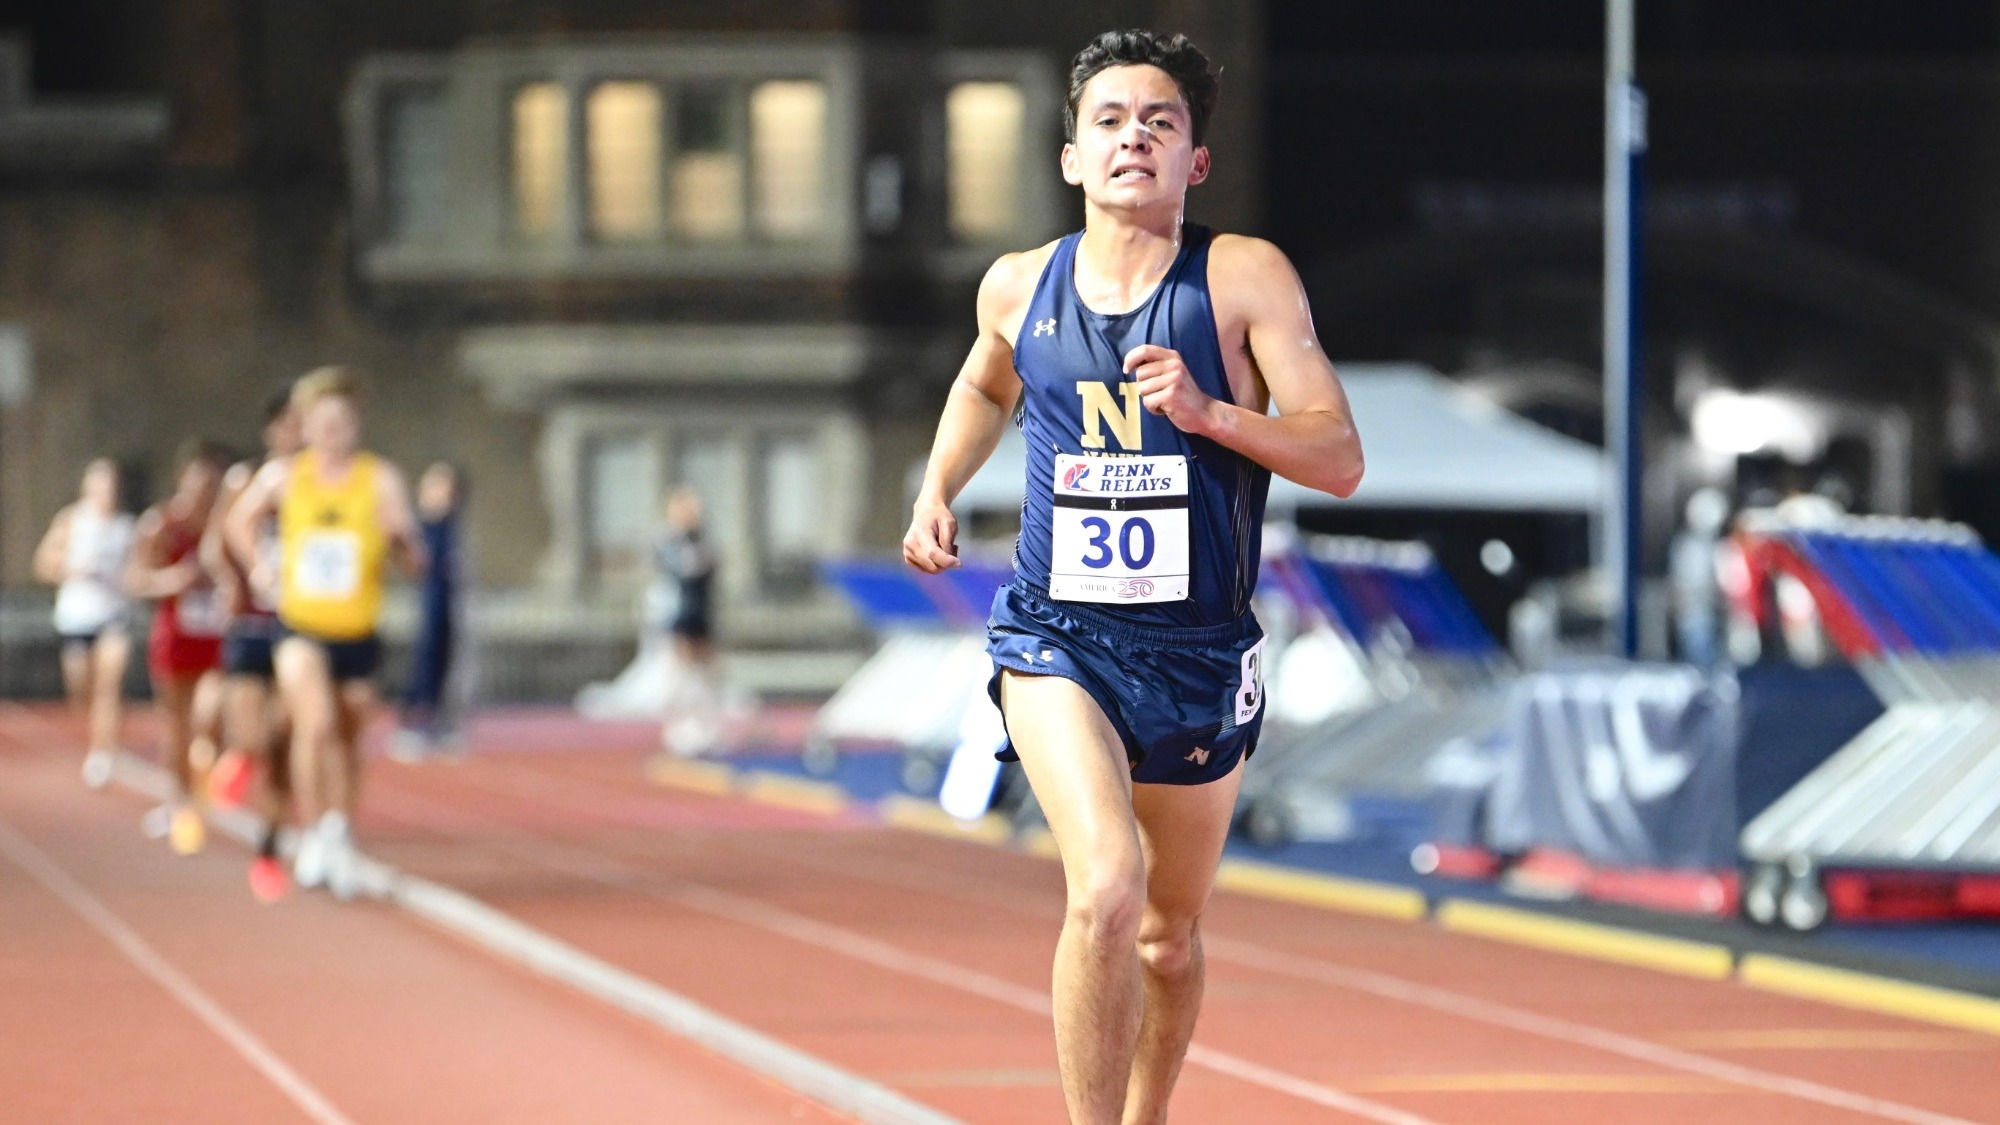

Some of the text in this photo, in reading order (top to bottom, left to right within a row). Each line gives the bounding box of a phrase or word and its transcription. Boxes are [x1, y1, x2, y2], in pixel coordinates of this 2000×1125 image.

[1076, 381, 1142, 450] N
[1102, 464, 1155, 477] PENN
[1100, 477, 1171, 492] RELAYS
[1081, 516, 1155, 570] 30
[1117, 579, 1155, 598] 250
